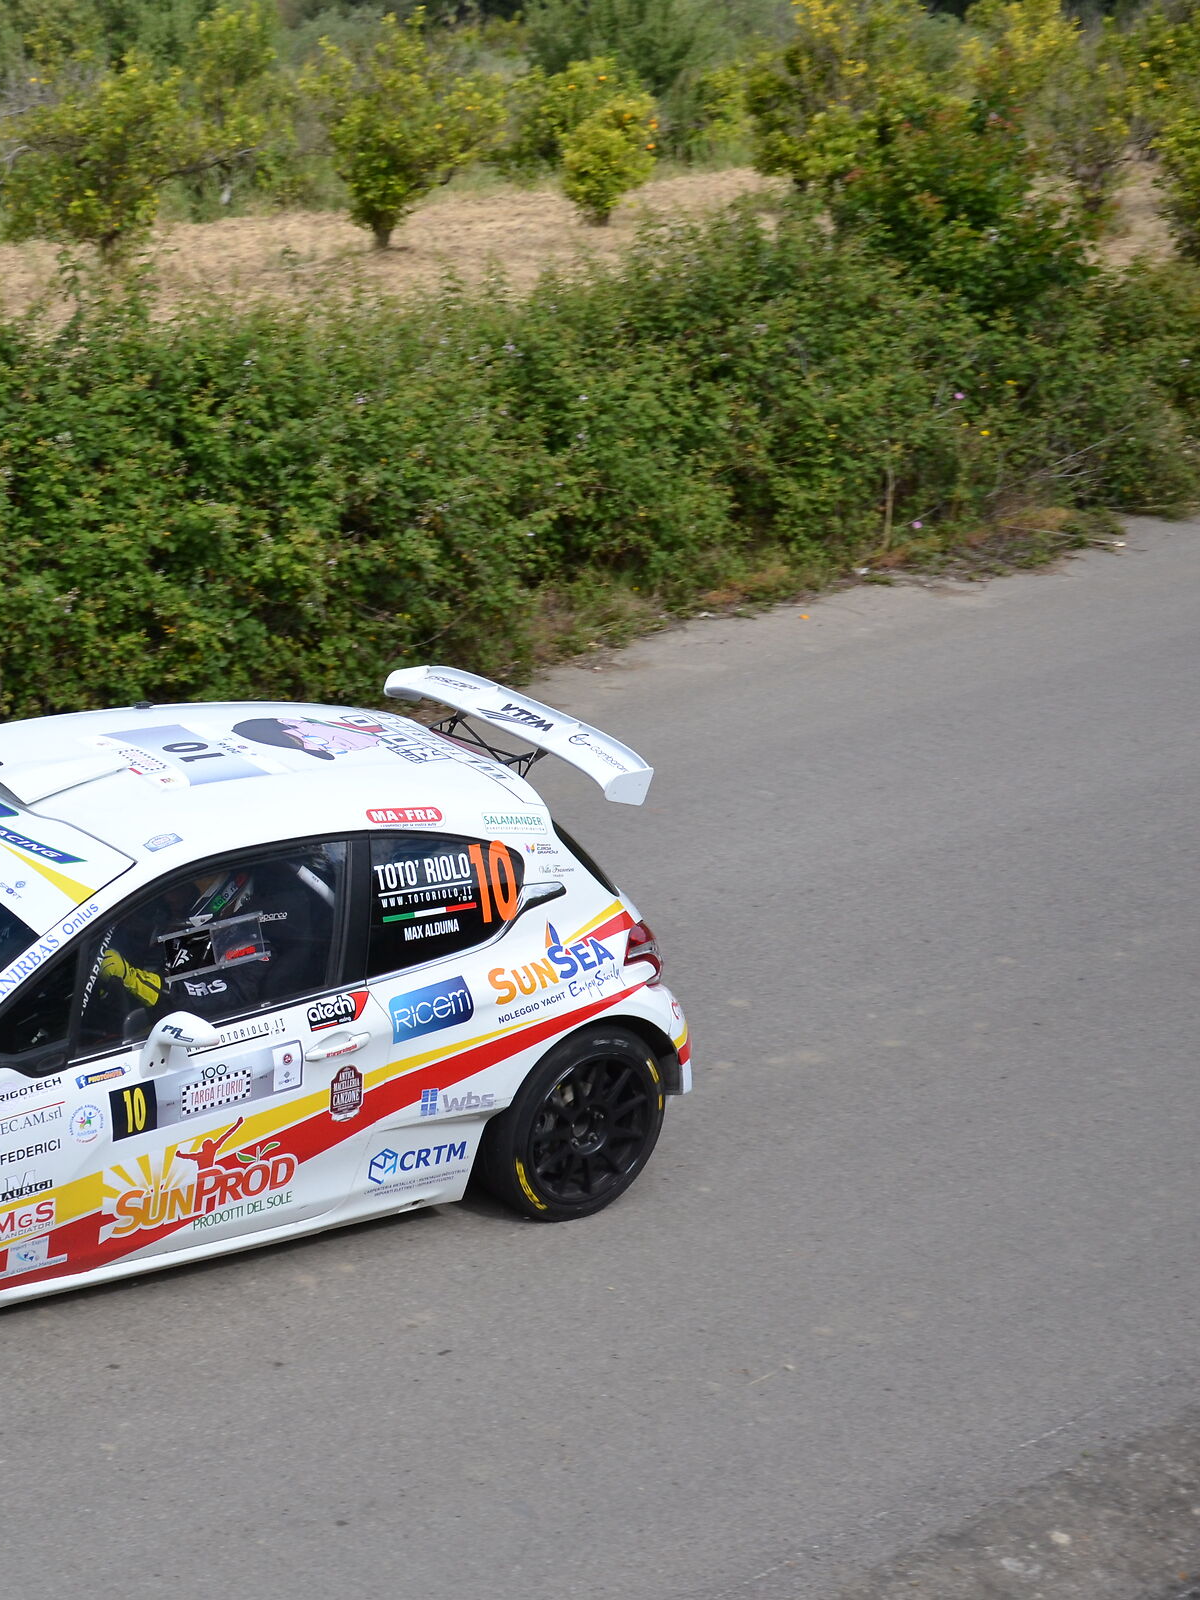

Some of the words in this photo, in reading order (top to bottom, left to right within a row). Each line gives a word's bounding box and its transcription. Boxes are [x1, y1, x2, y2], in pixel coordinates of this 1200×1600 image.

[162, 741, 225, 763] 10
[483, 814, 543, 827] SALAMANDER
[425, 853, 471, 883] RIOLO
[468, 839, 518, 923] 10
[381, 886, 472, 908] WWW.TOTORIOLO.IT
[62, 903, 99, 935] Onlus
[404, 926, 424, 941] MAX
[425, 918, 460, 938] ALDUINA
[306, 994, 356, 1022] atech
[498, 1002, 540, 1024] NOLEGGIO
[540, 991, 566, 1008] YACHT
[201, 1064, 227, 1080] 100
[338, 1069, 355, 1083] ANTICA
[190, 1088, 215, 1106] TARGA
[216, 1078, 245, 1099] FLORIO
[332, 1088, 362, 1106] CANZONE
[443, 1091, 495, 1113] wbs
[123, 1087, 146, 1133] 10
[0, 1138, 61, 1166] FEDERICI
[399, 1140, 467, 1171] CRTM
[192, 1206, 244, 1231] PRODOTTI
[246, 1200, 265, 1218] DEL
[266, 1191, 292, 1208] SOLE
